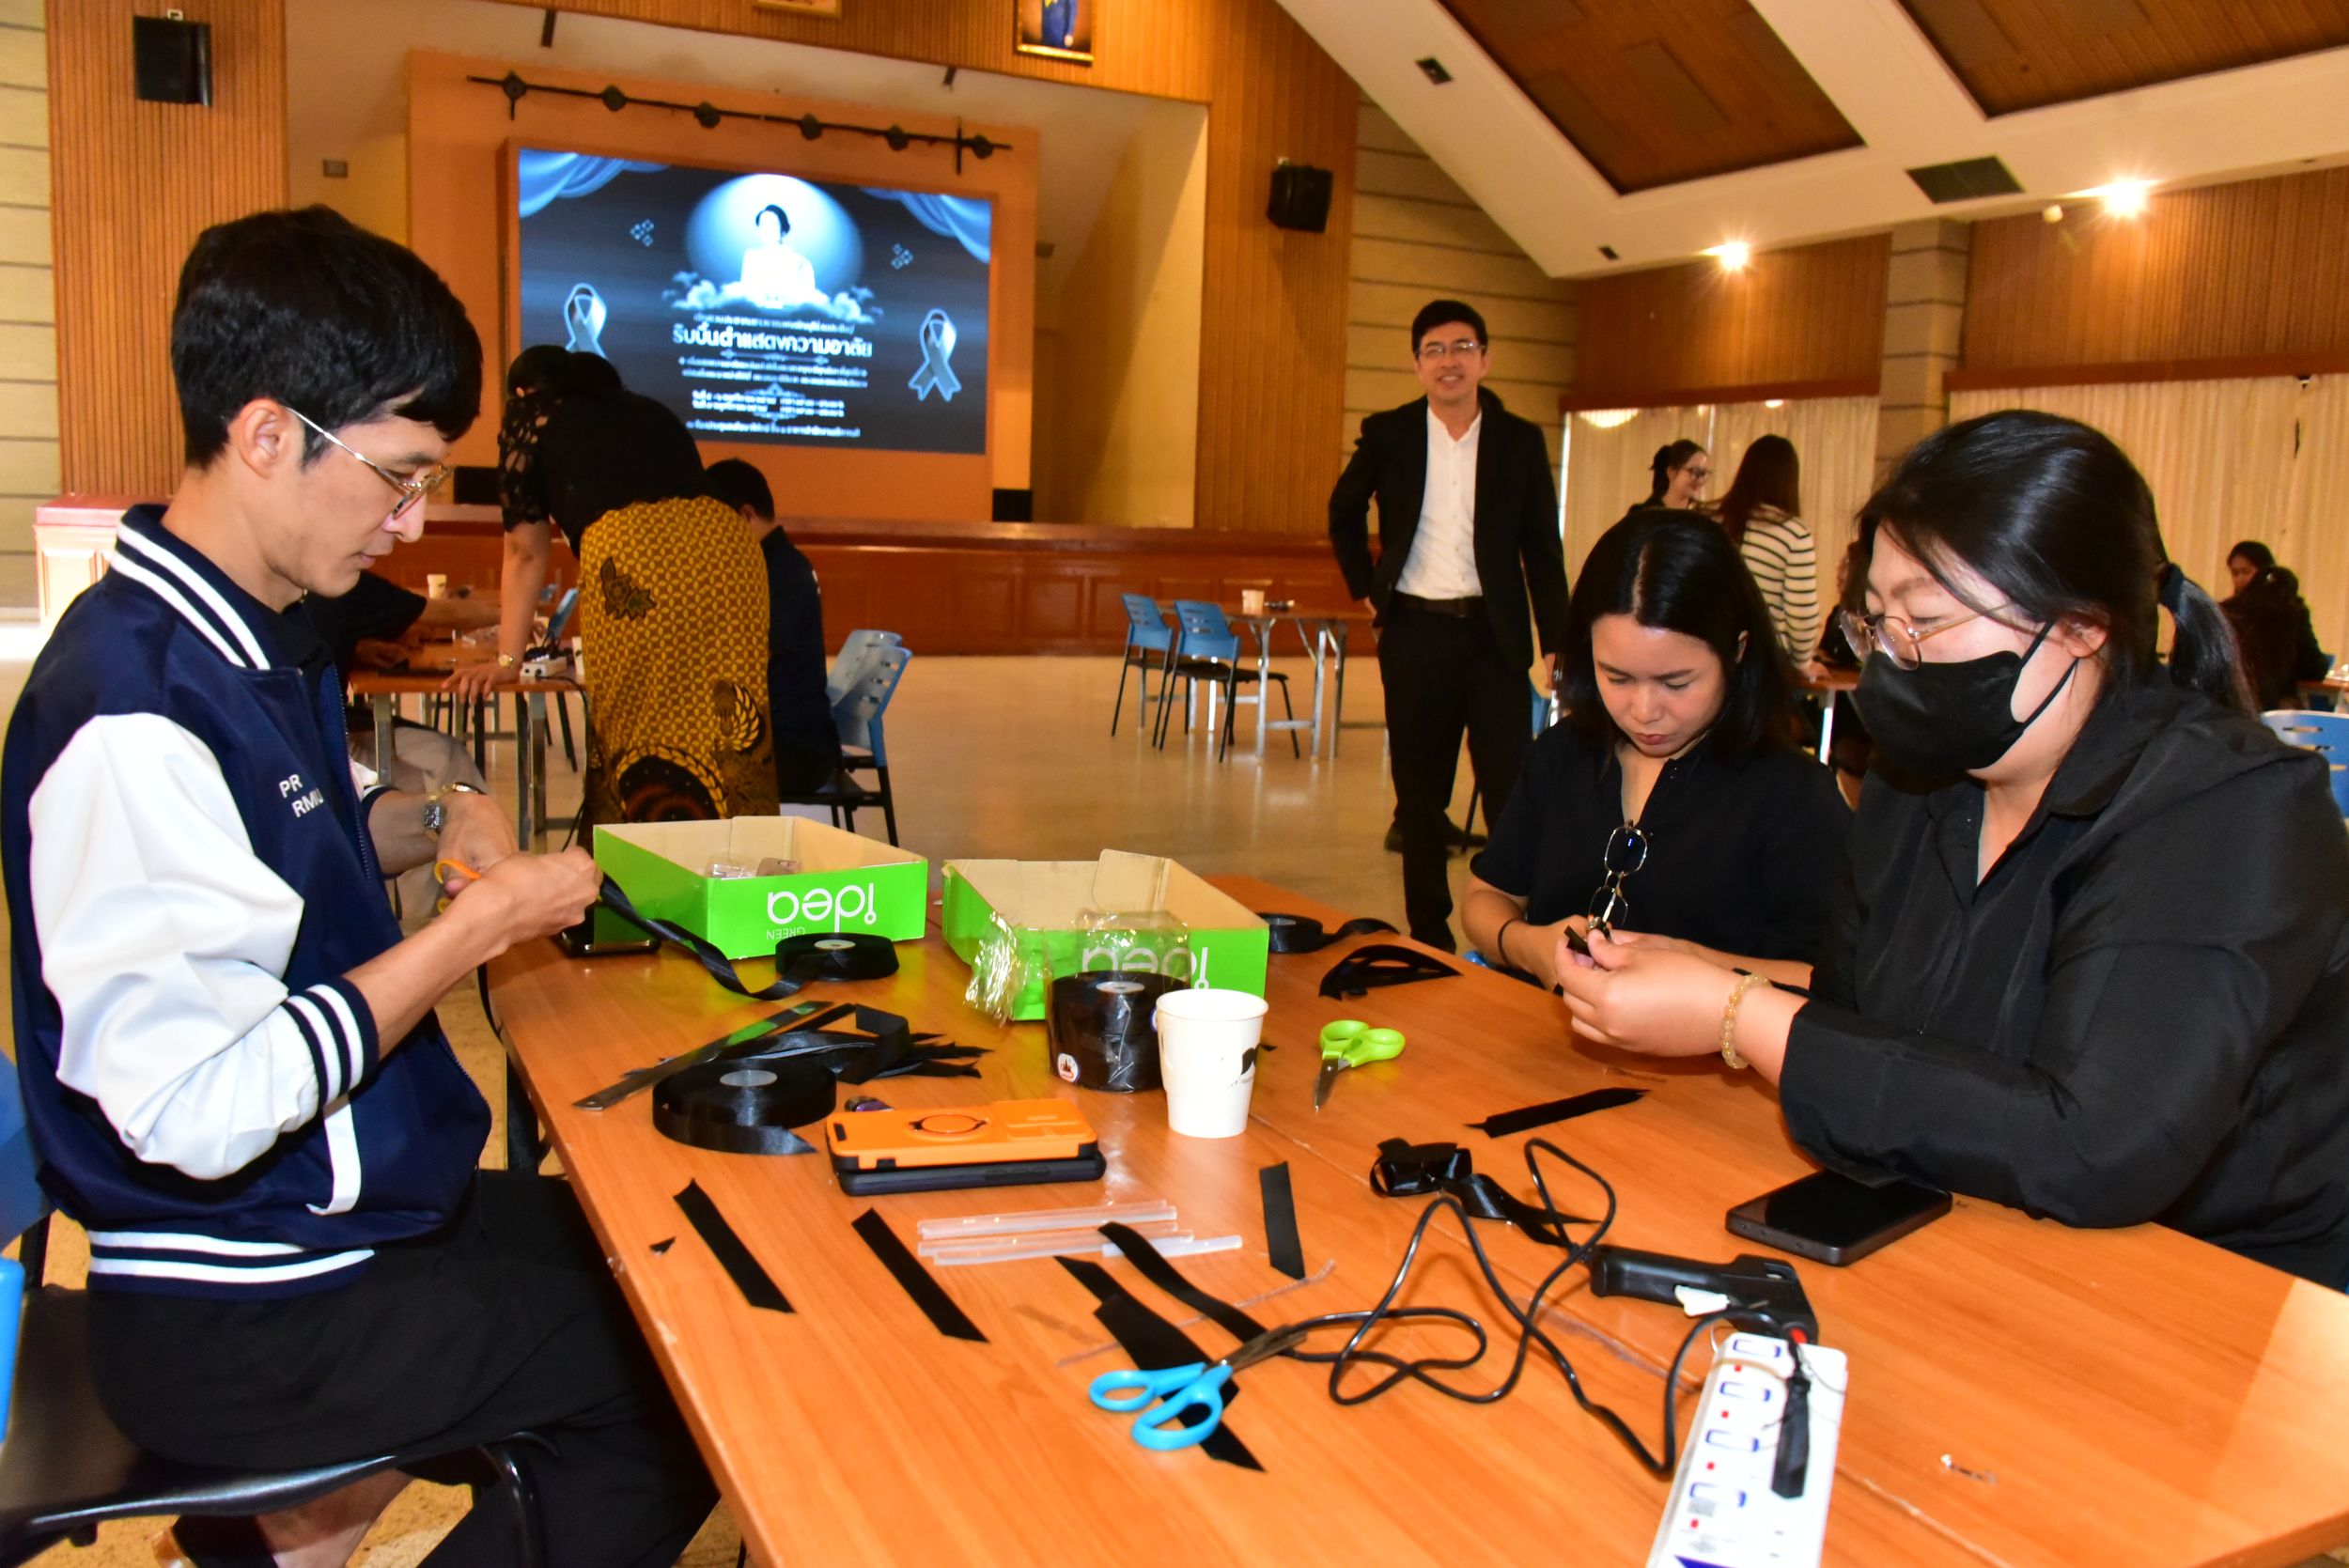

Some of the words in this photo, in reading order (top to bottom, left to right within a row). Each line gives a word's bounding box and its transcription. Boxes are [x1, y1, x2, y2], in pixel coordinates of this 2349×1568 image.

[279, 774, 303, 799] PR
[767, 882, 877, 933] idea
[766, 926, 806, 940] GREEN
